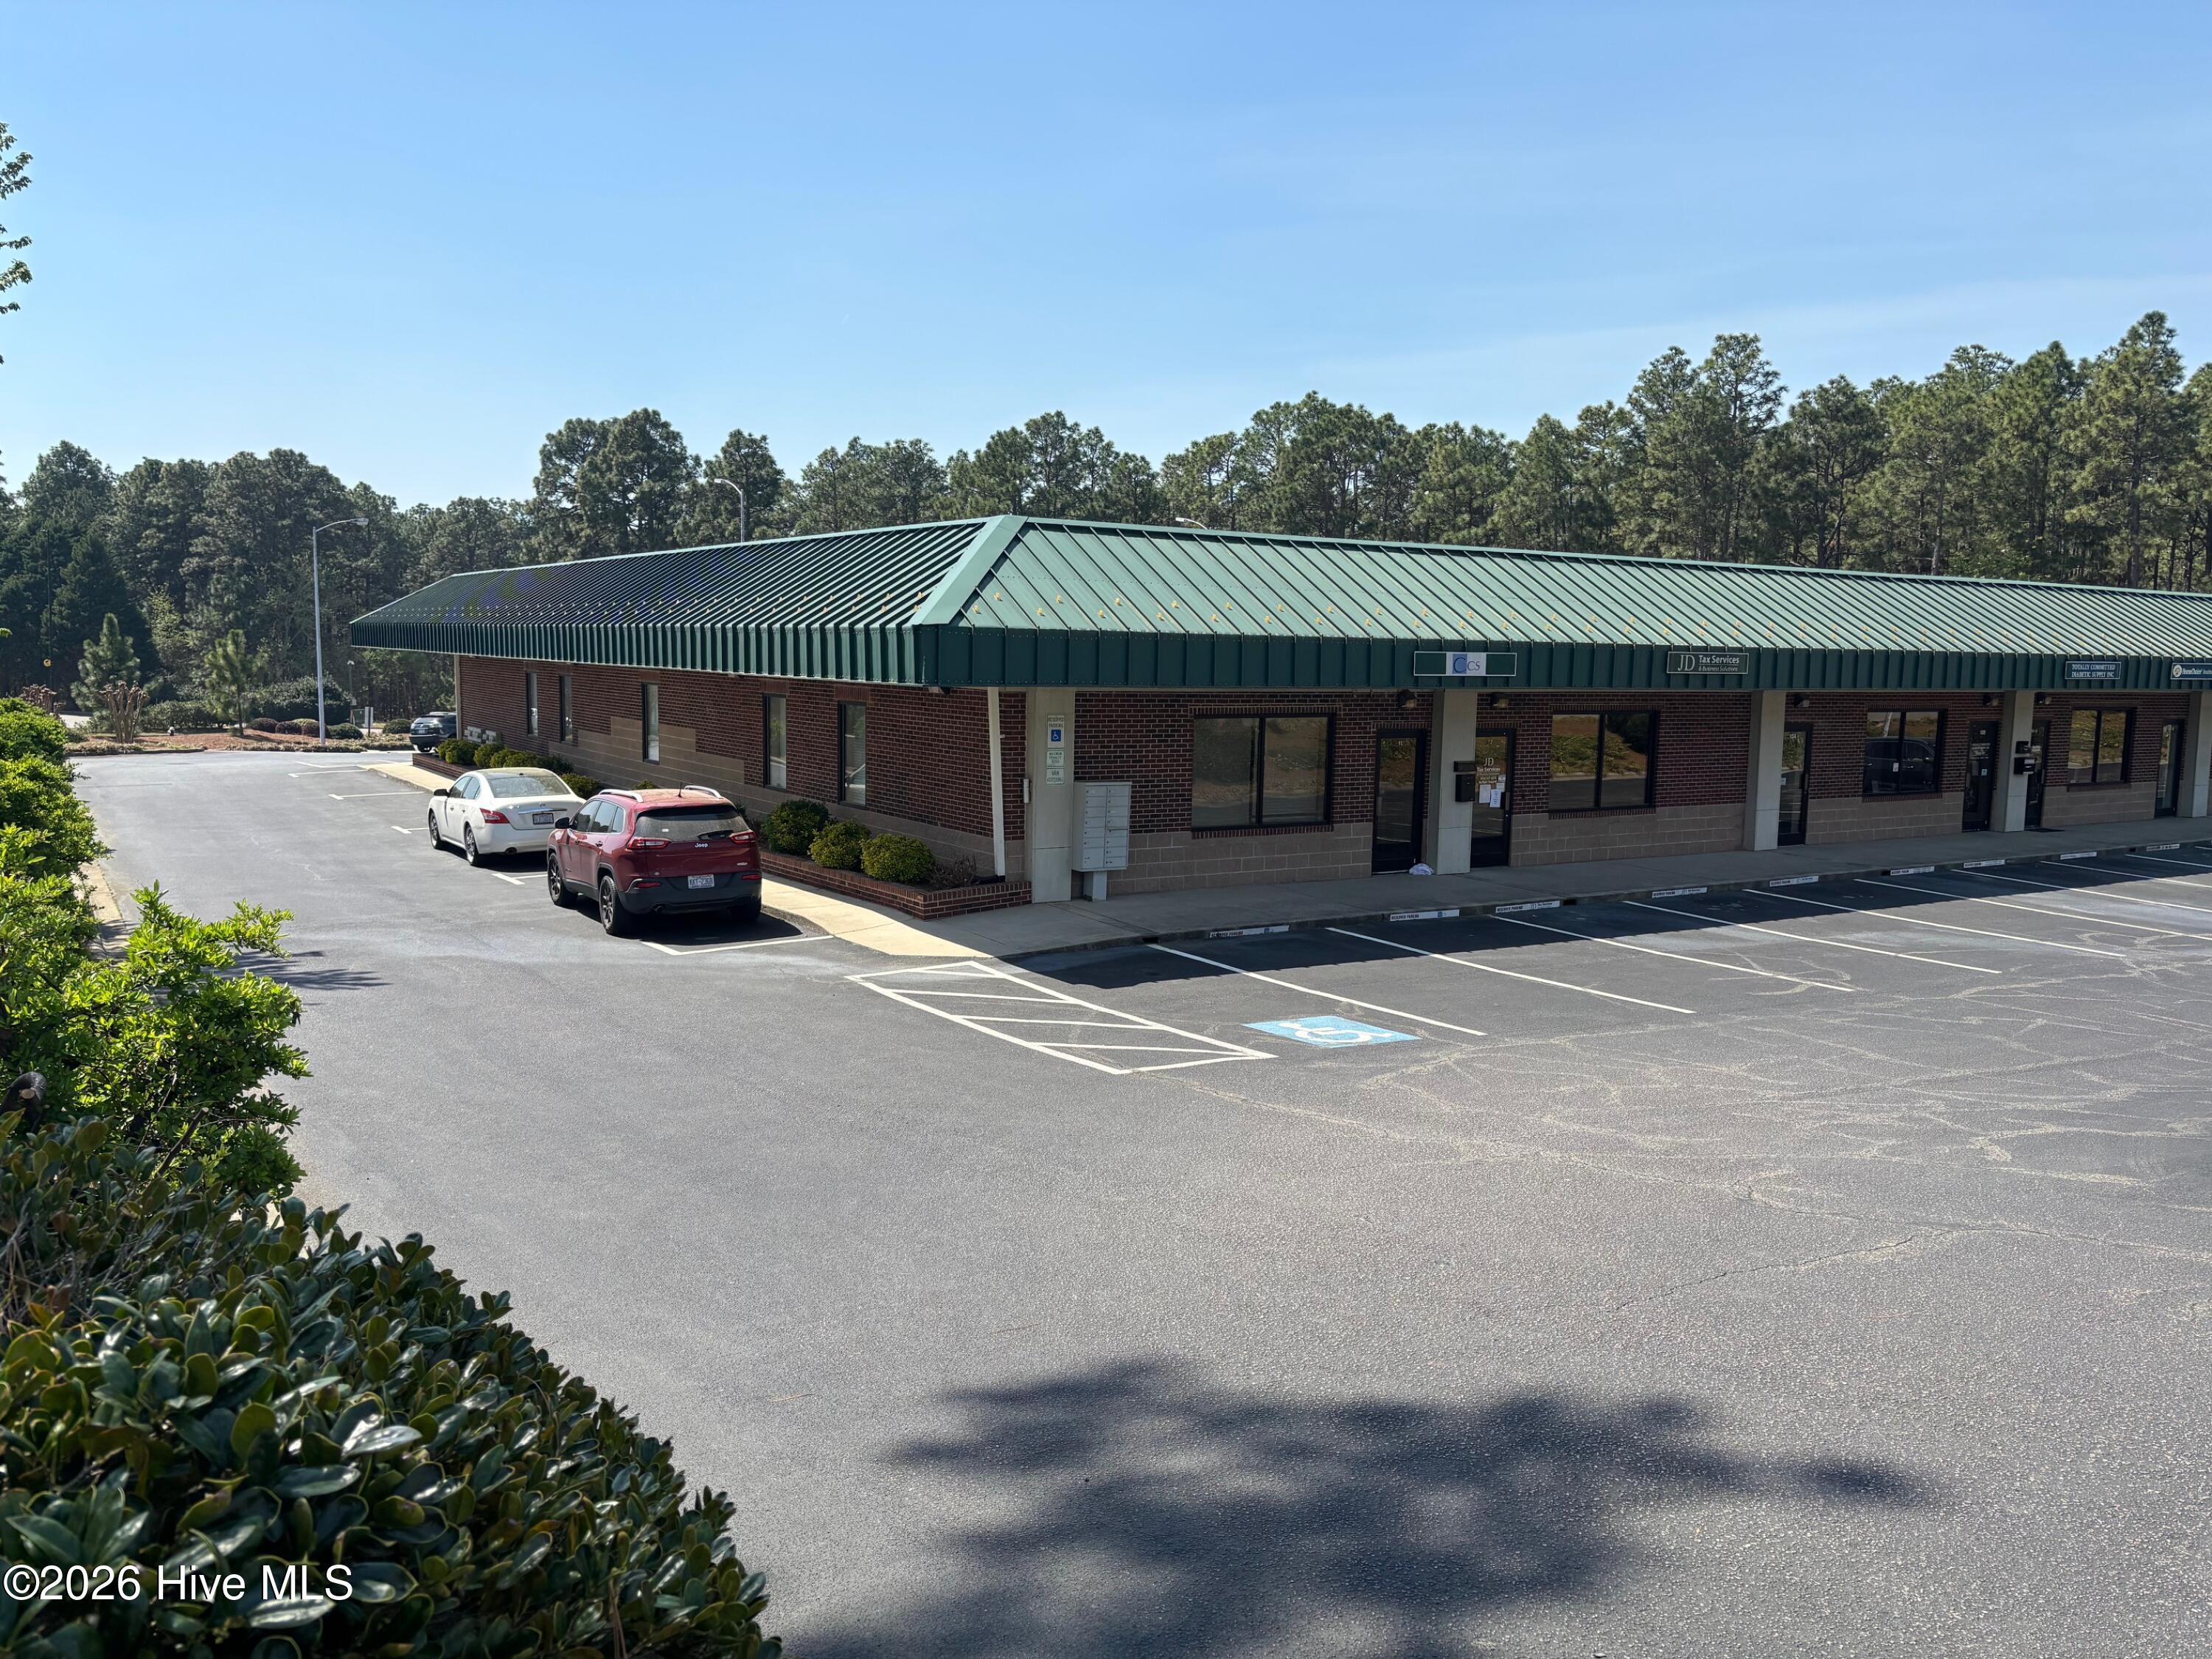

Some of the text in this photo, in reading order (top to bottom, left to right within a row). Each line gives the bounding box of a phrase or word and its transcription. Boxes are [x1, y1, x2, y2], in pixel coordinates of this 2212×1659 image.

[1677, 655, 1695, 672] JD
[1699, 655, 1739, 664] Tax Services
[1484, 757, 1494, 766] JD
